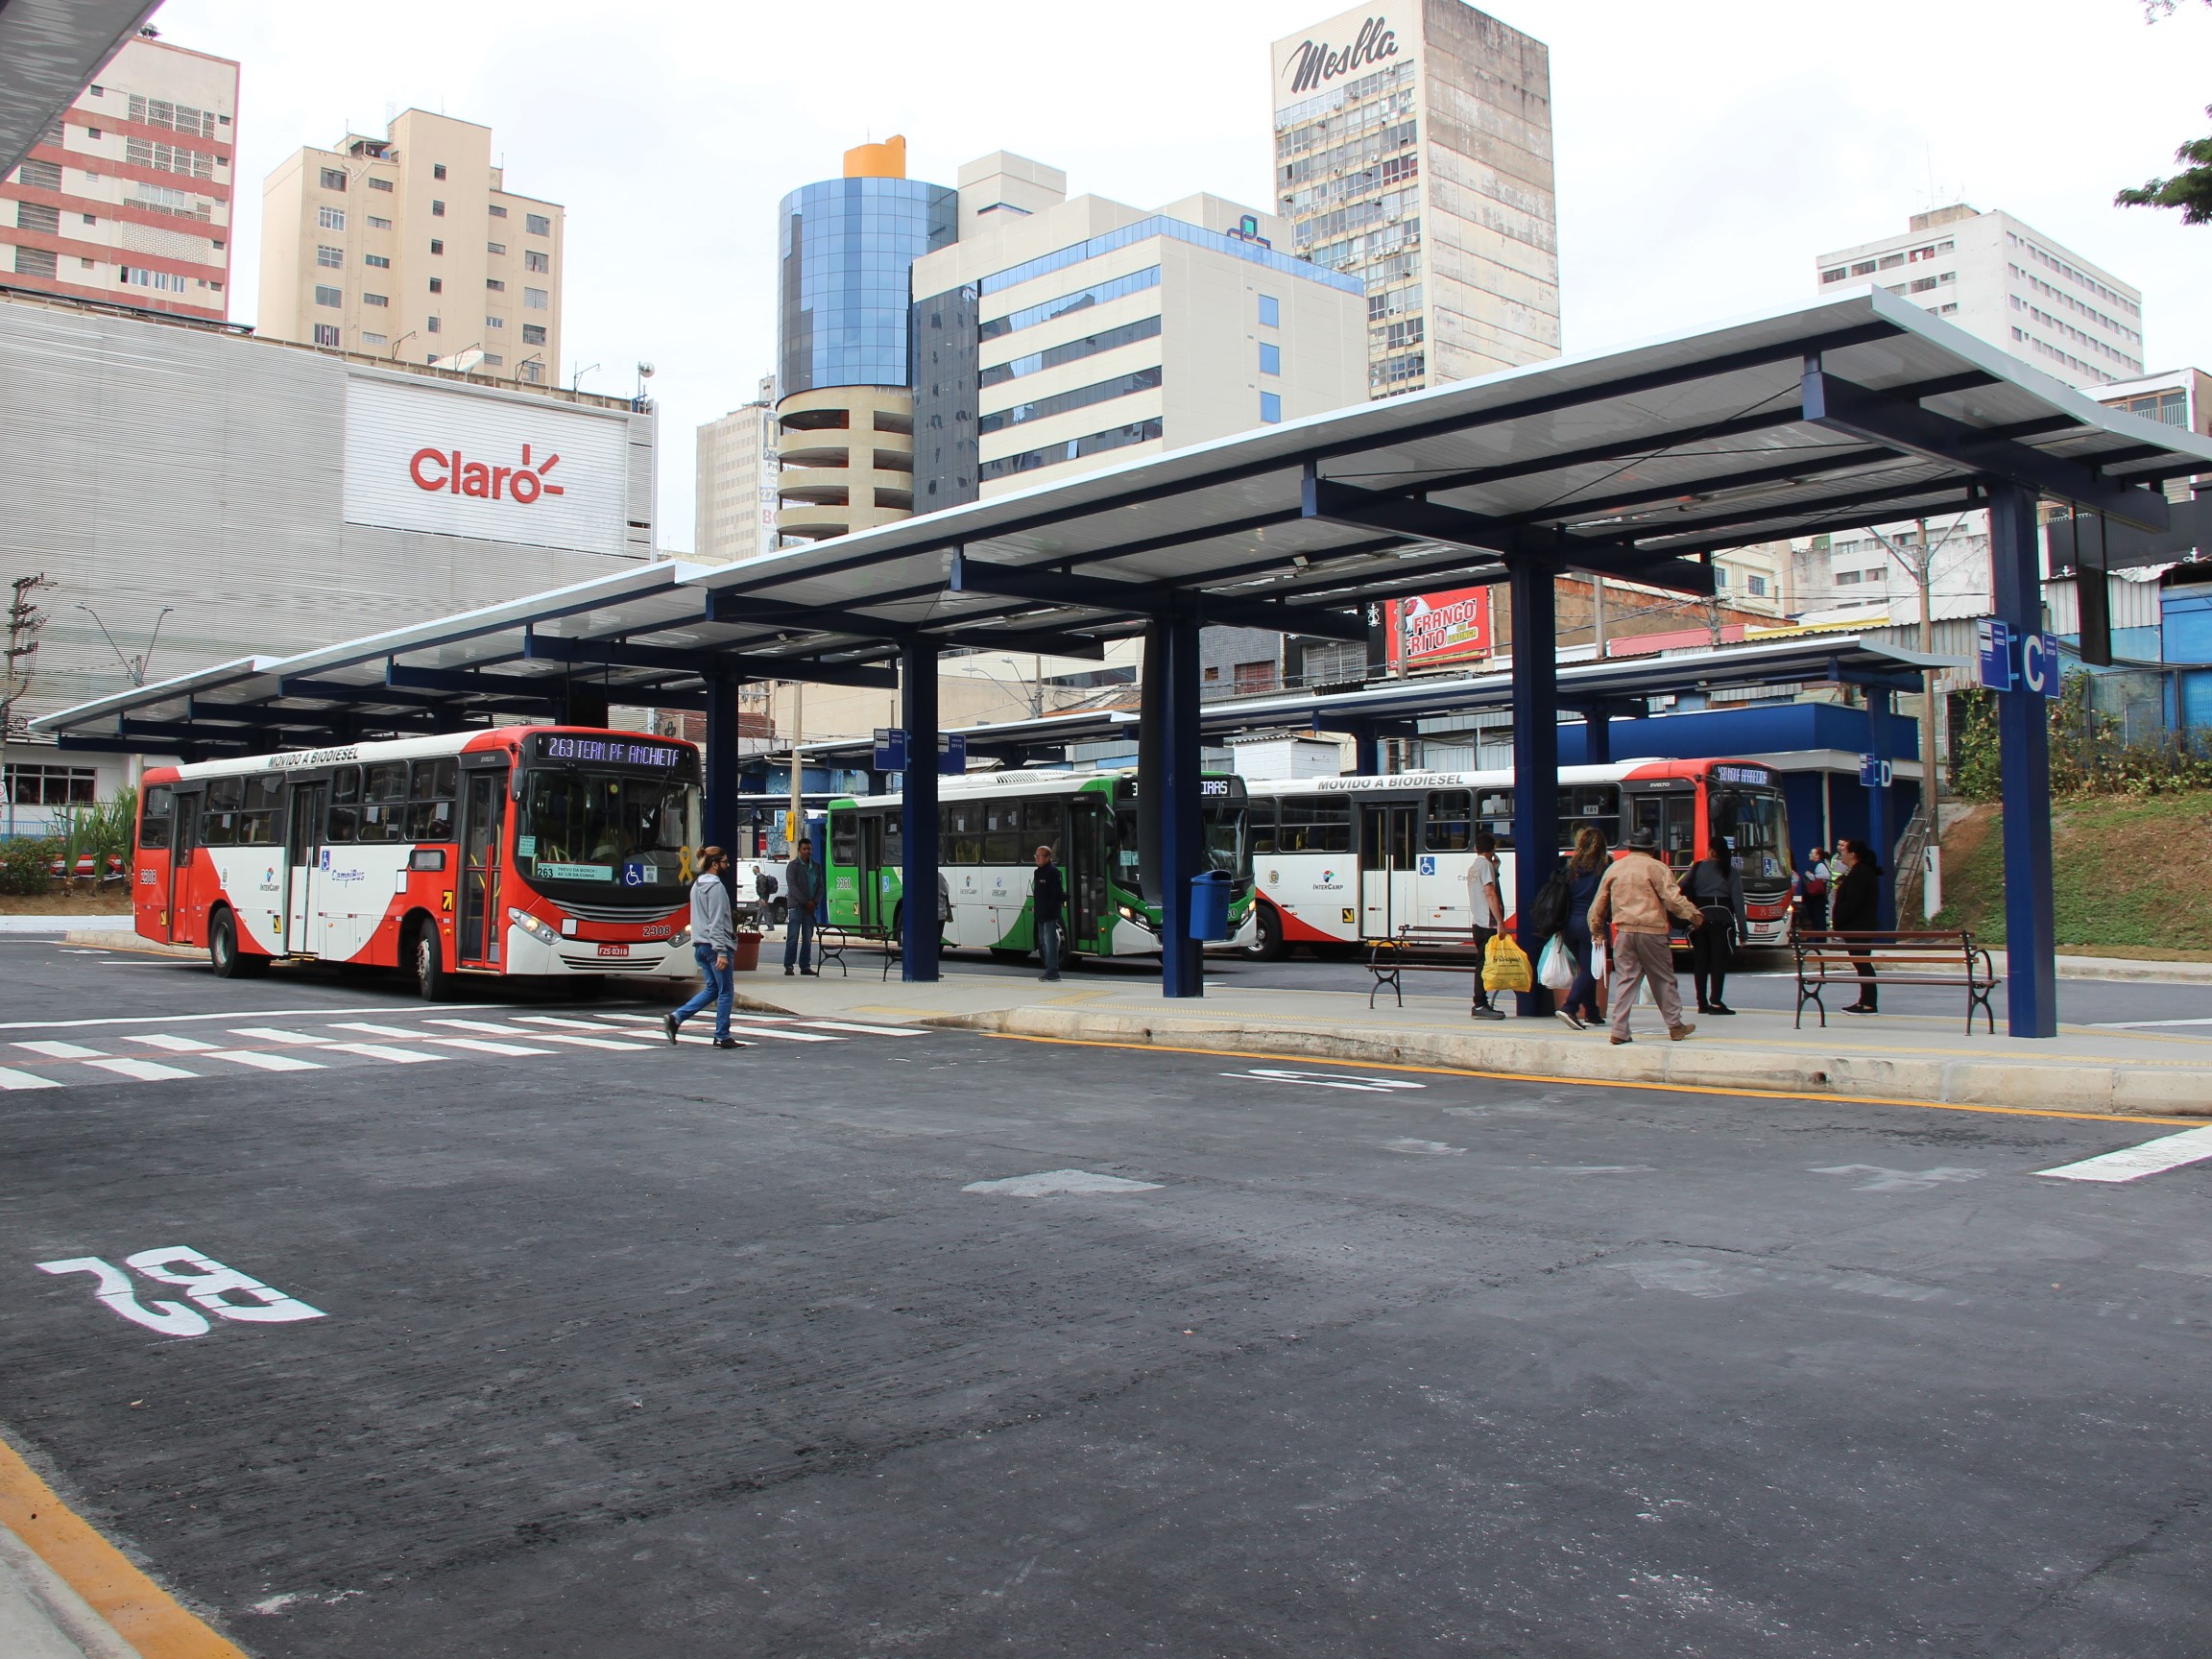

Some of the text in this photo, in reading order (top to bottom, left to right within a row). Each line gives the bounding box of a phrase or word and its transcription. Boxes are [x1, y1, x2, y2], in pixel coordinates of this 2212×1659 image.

[1282, 16, 1399, 94] Mesbla
[410, 444, 564, 504] Claro
[1413, 602, 1475, 634] FRANGO
[2024, 635, 2044, 692] C
[268, 747, 359, 767] MOVIDO A BIODIESEL
[1318, 774, 1464, 790] MOVIDO A BIODIESEL
[1881, 760, 1891, 786] D
[1200, 781, 1228, 795] IRAS
[538, 868, 554, 878] 263
[643, 926, 671, 937] 2308
